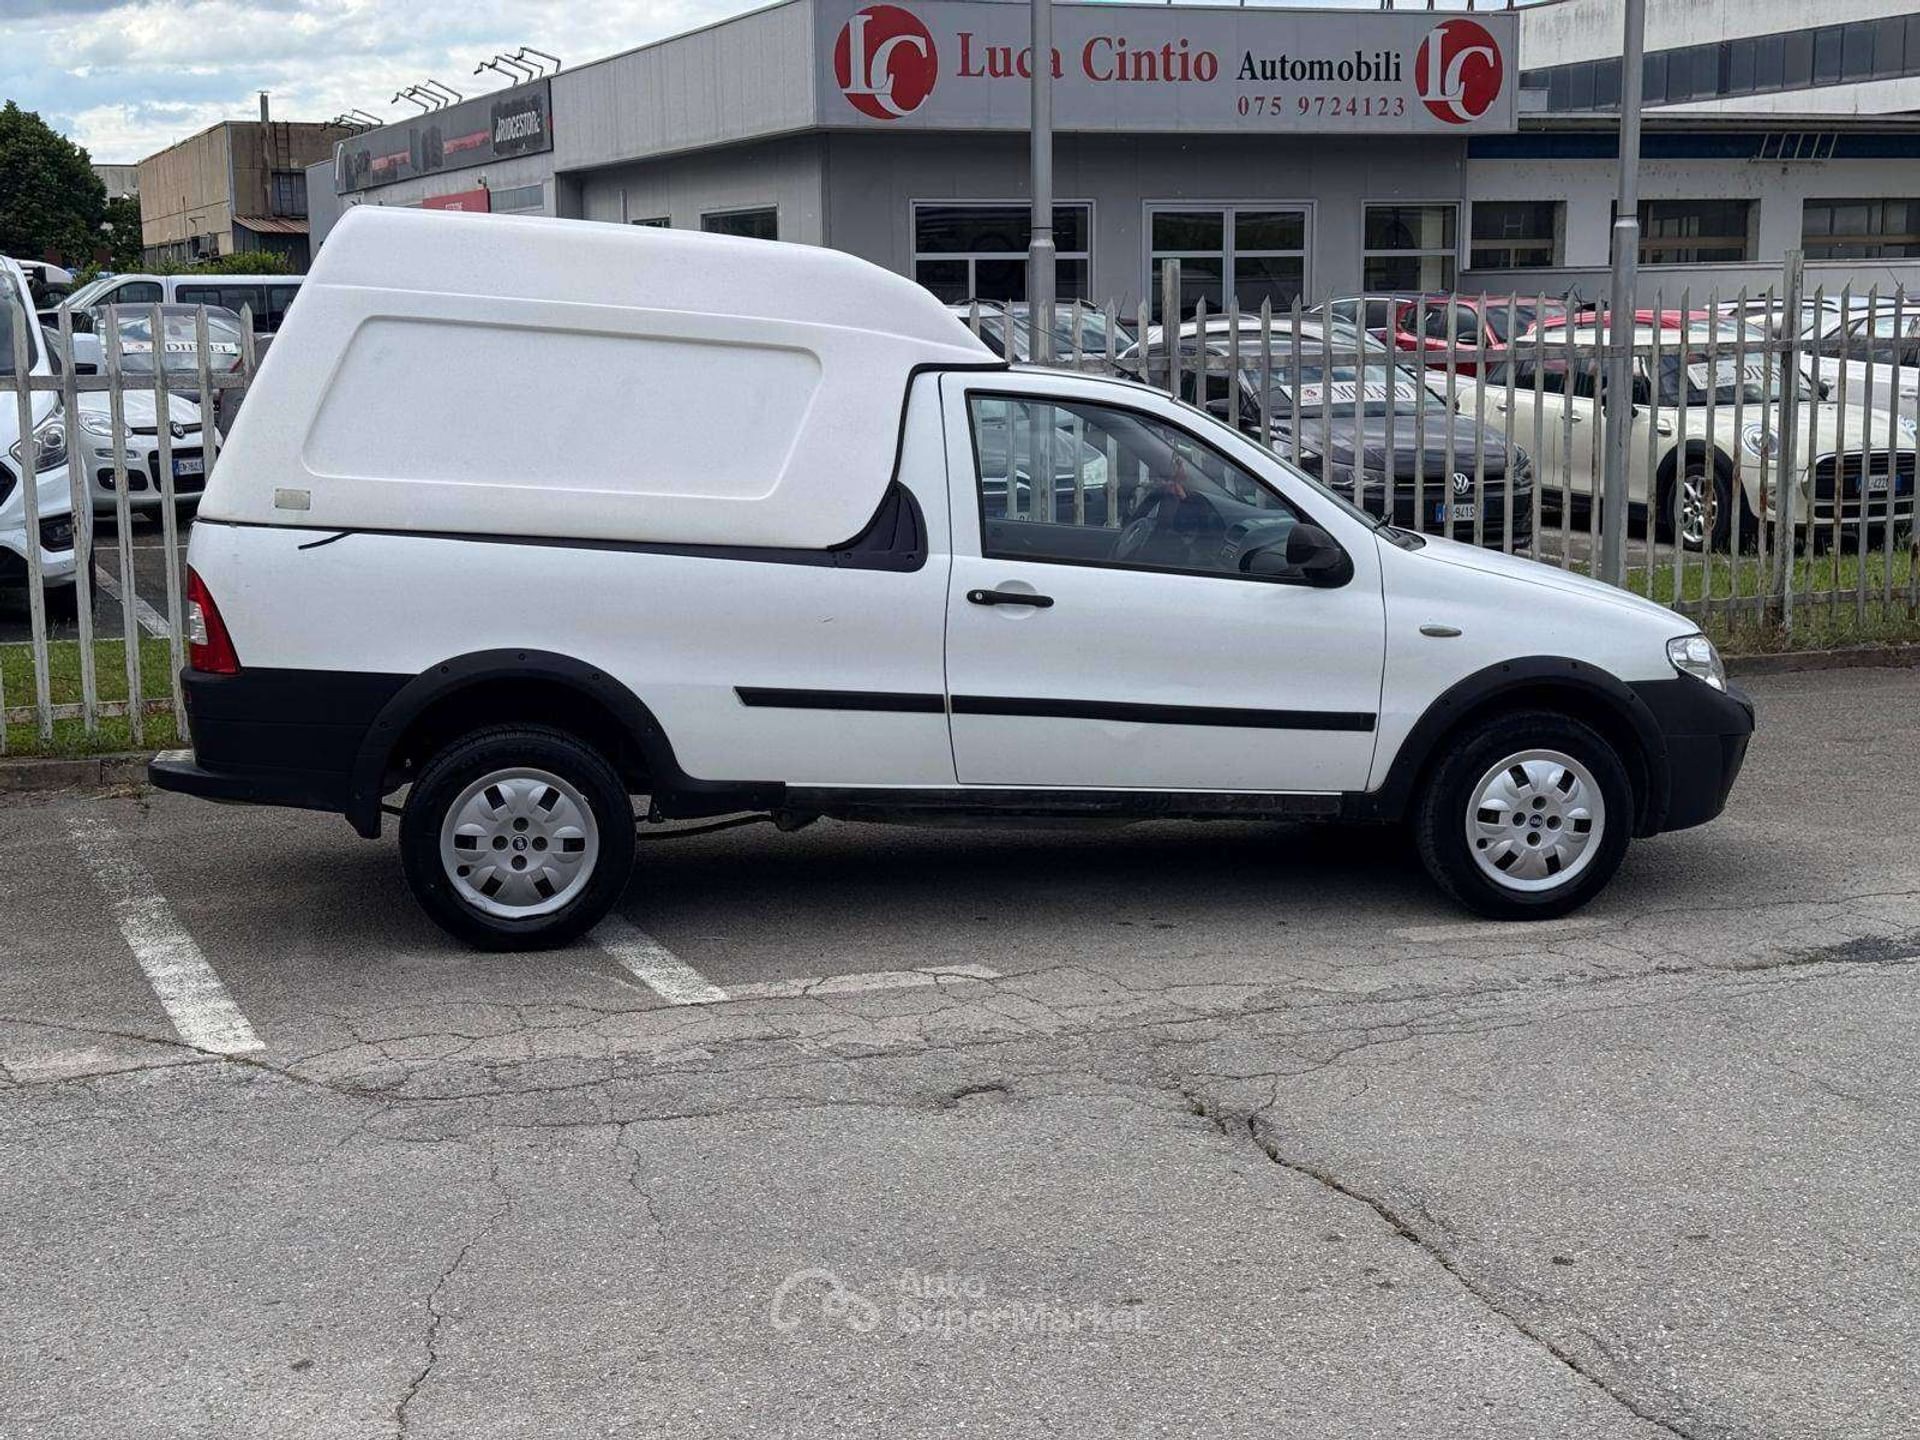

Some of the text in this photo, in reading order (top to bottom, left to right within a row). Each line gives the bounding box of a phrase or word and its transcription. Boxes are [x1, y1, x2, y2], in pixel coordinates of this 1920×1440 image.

[1081, 36, 1218, 82] Cintio
[1235, 50, 1402, 82] Automobili
[1237, 96, 1405, 117] 075 9724123
[166, 343, 233, 353] DIEEL
